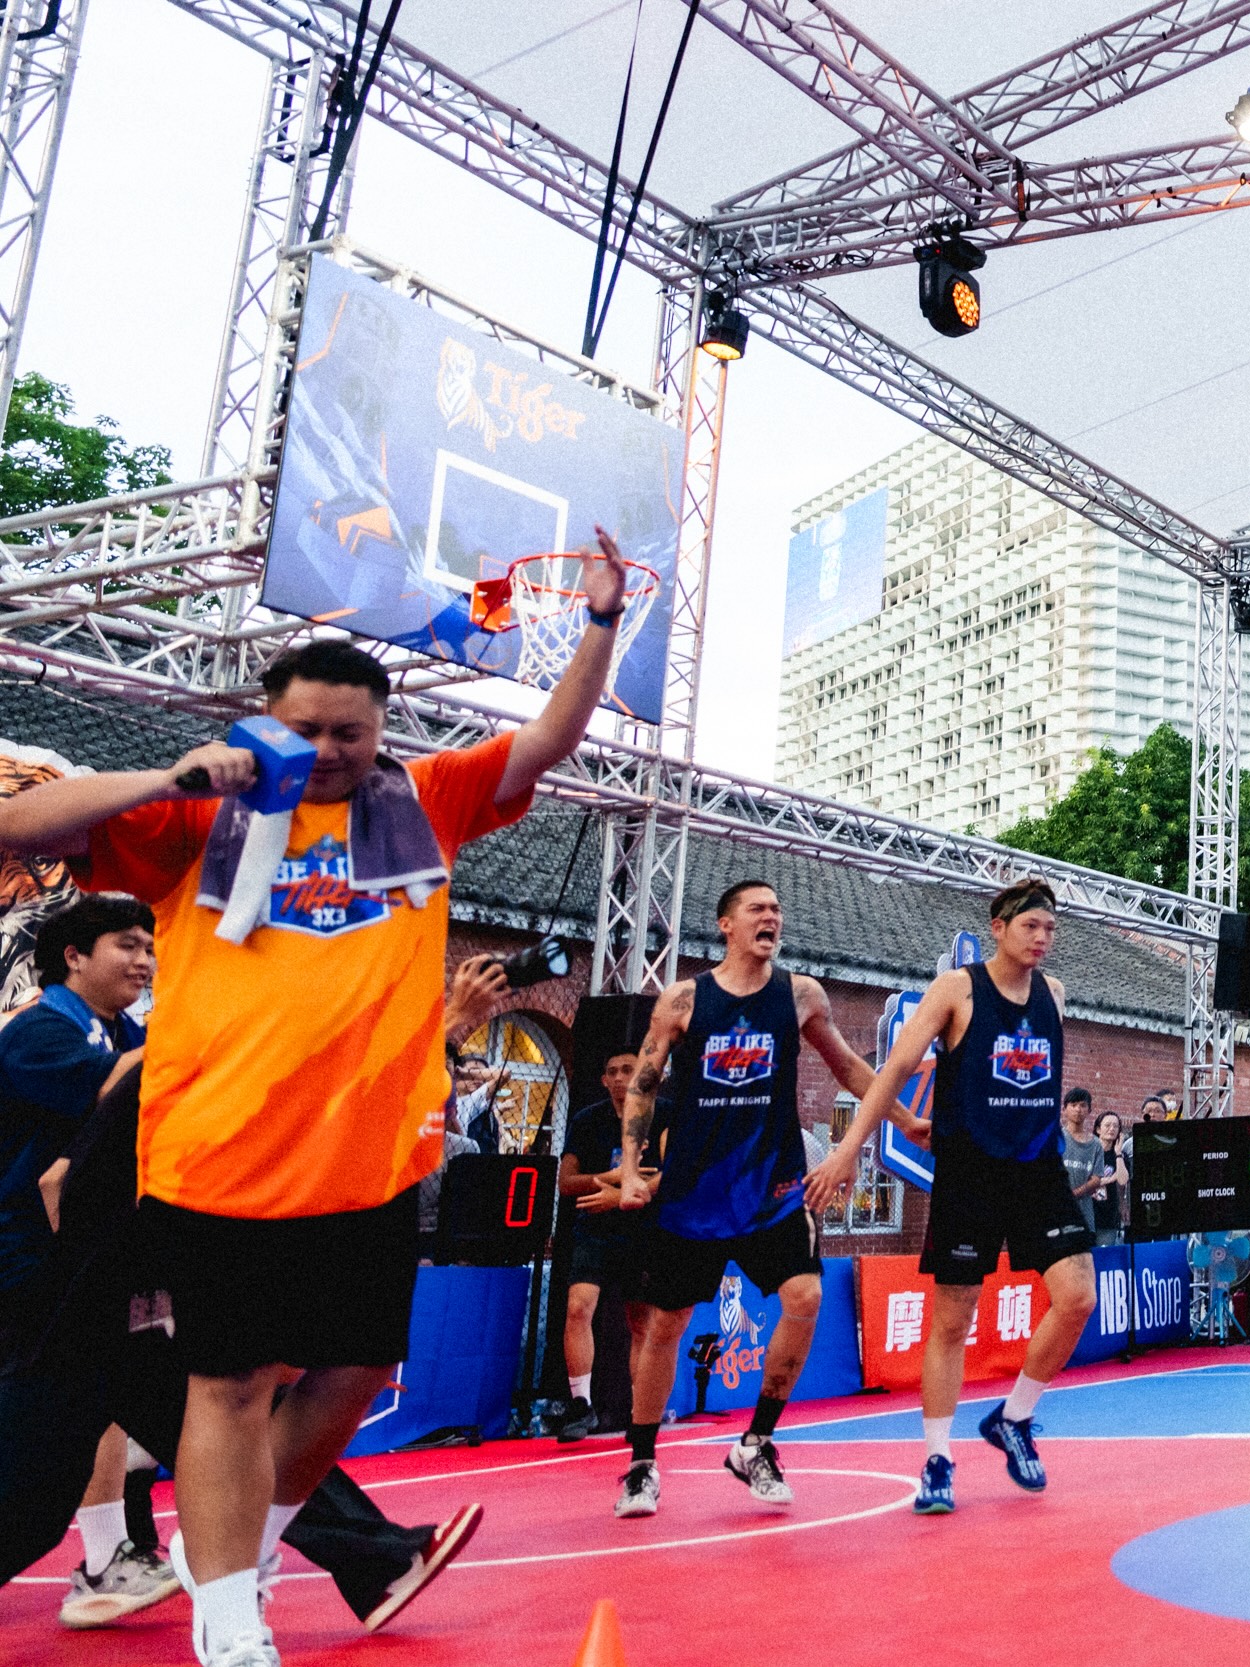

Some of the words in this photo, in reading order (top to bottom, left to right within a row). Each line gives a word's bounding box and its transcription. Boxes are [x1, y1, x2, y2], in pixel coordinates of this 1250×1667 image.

[483, 361, 586, 442] Tiger
[276, 860, 307, 882] BE
[312, 909, 347, 927] 3X3
[709, 1035, 731, 1052] BE
[735, 1033, 773, 1051] LIKE
[997, 1035, 1016, 1053] BE
[1019, 1038, 1049, 1054] LIKE
[728, 1067, 747, 1079] 3X3
[698, 1097, 729, 1107] TAIPEI
[730, 1095, 772, 1106] KNIGHTS
[988, 1097, 1018, 1107] TAIPEI
[1019, 1097, 1055, 1107] KNIGHTS
[1203, 1151, 1229, 1161] PERIOD
[505, 1166, 538, 1228] 0
[1141, 1191, 1166, 1202] FOULS
[1198, 1188, 1214, 1198] SHOT
[1215, 1187, 1235, 1197] CLOCK
[1142, 1267, 1182, 1329] Store
[885, 1283, 1033, 1353] 摩頓
[705, 1336, 765, 1389] iger
